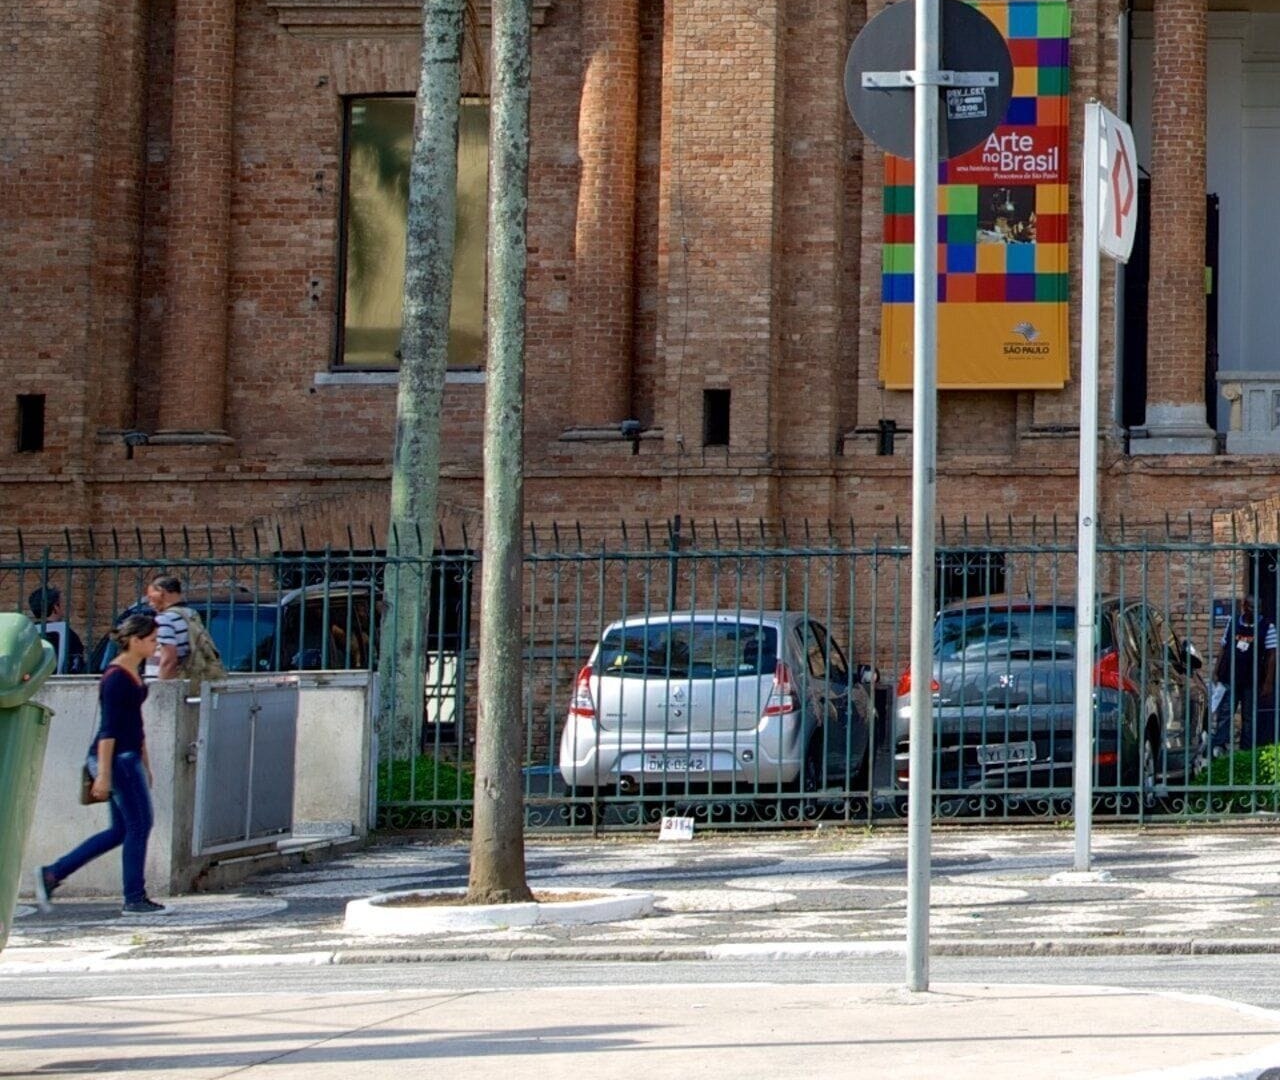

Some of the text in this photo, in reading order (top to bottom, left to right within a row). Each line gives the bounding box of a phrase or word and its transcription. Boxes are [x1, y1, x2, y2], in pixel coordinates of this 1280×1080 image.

[984, 131, 1033, 152] Arte
[982, 146, 1058, 171] no Brasil
[1003, 344, 1050, 355] SÃO PAULO
